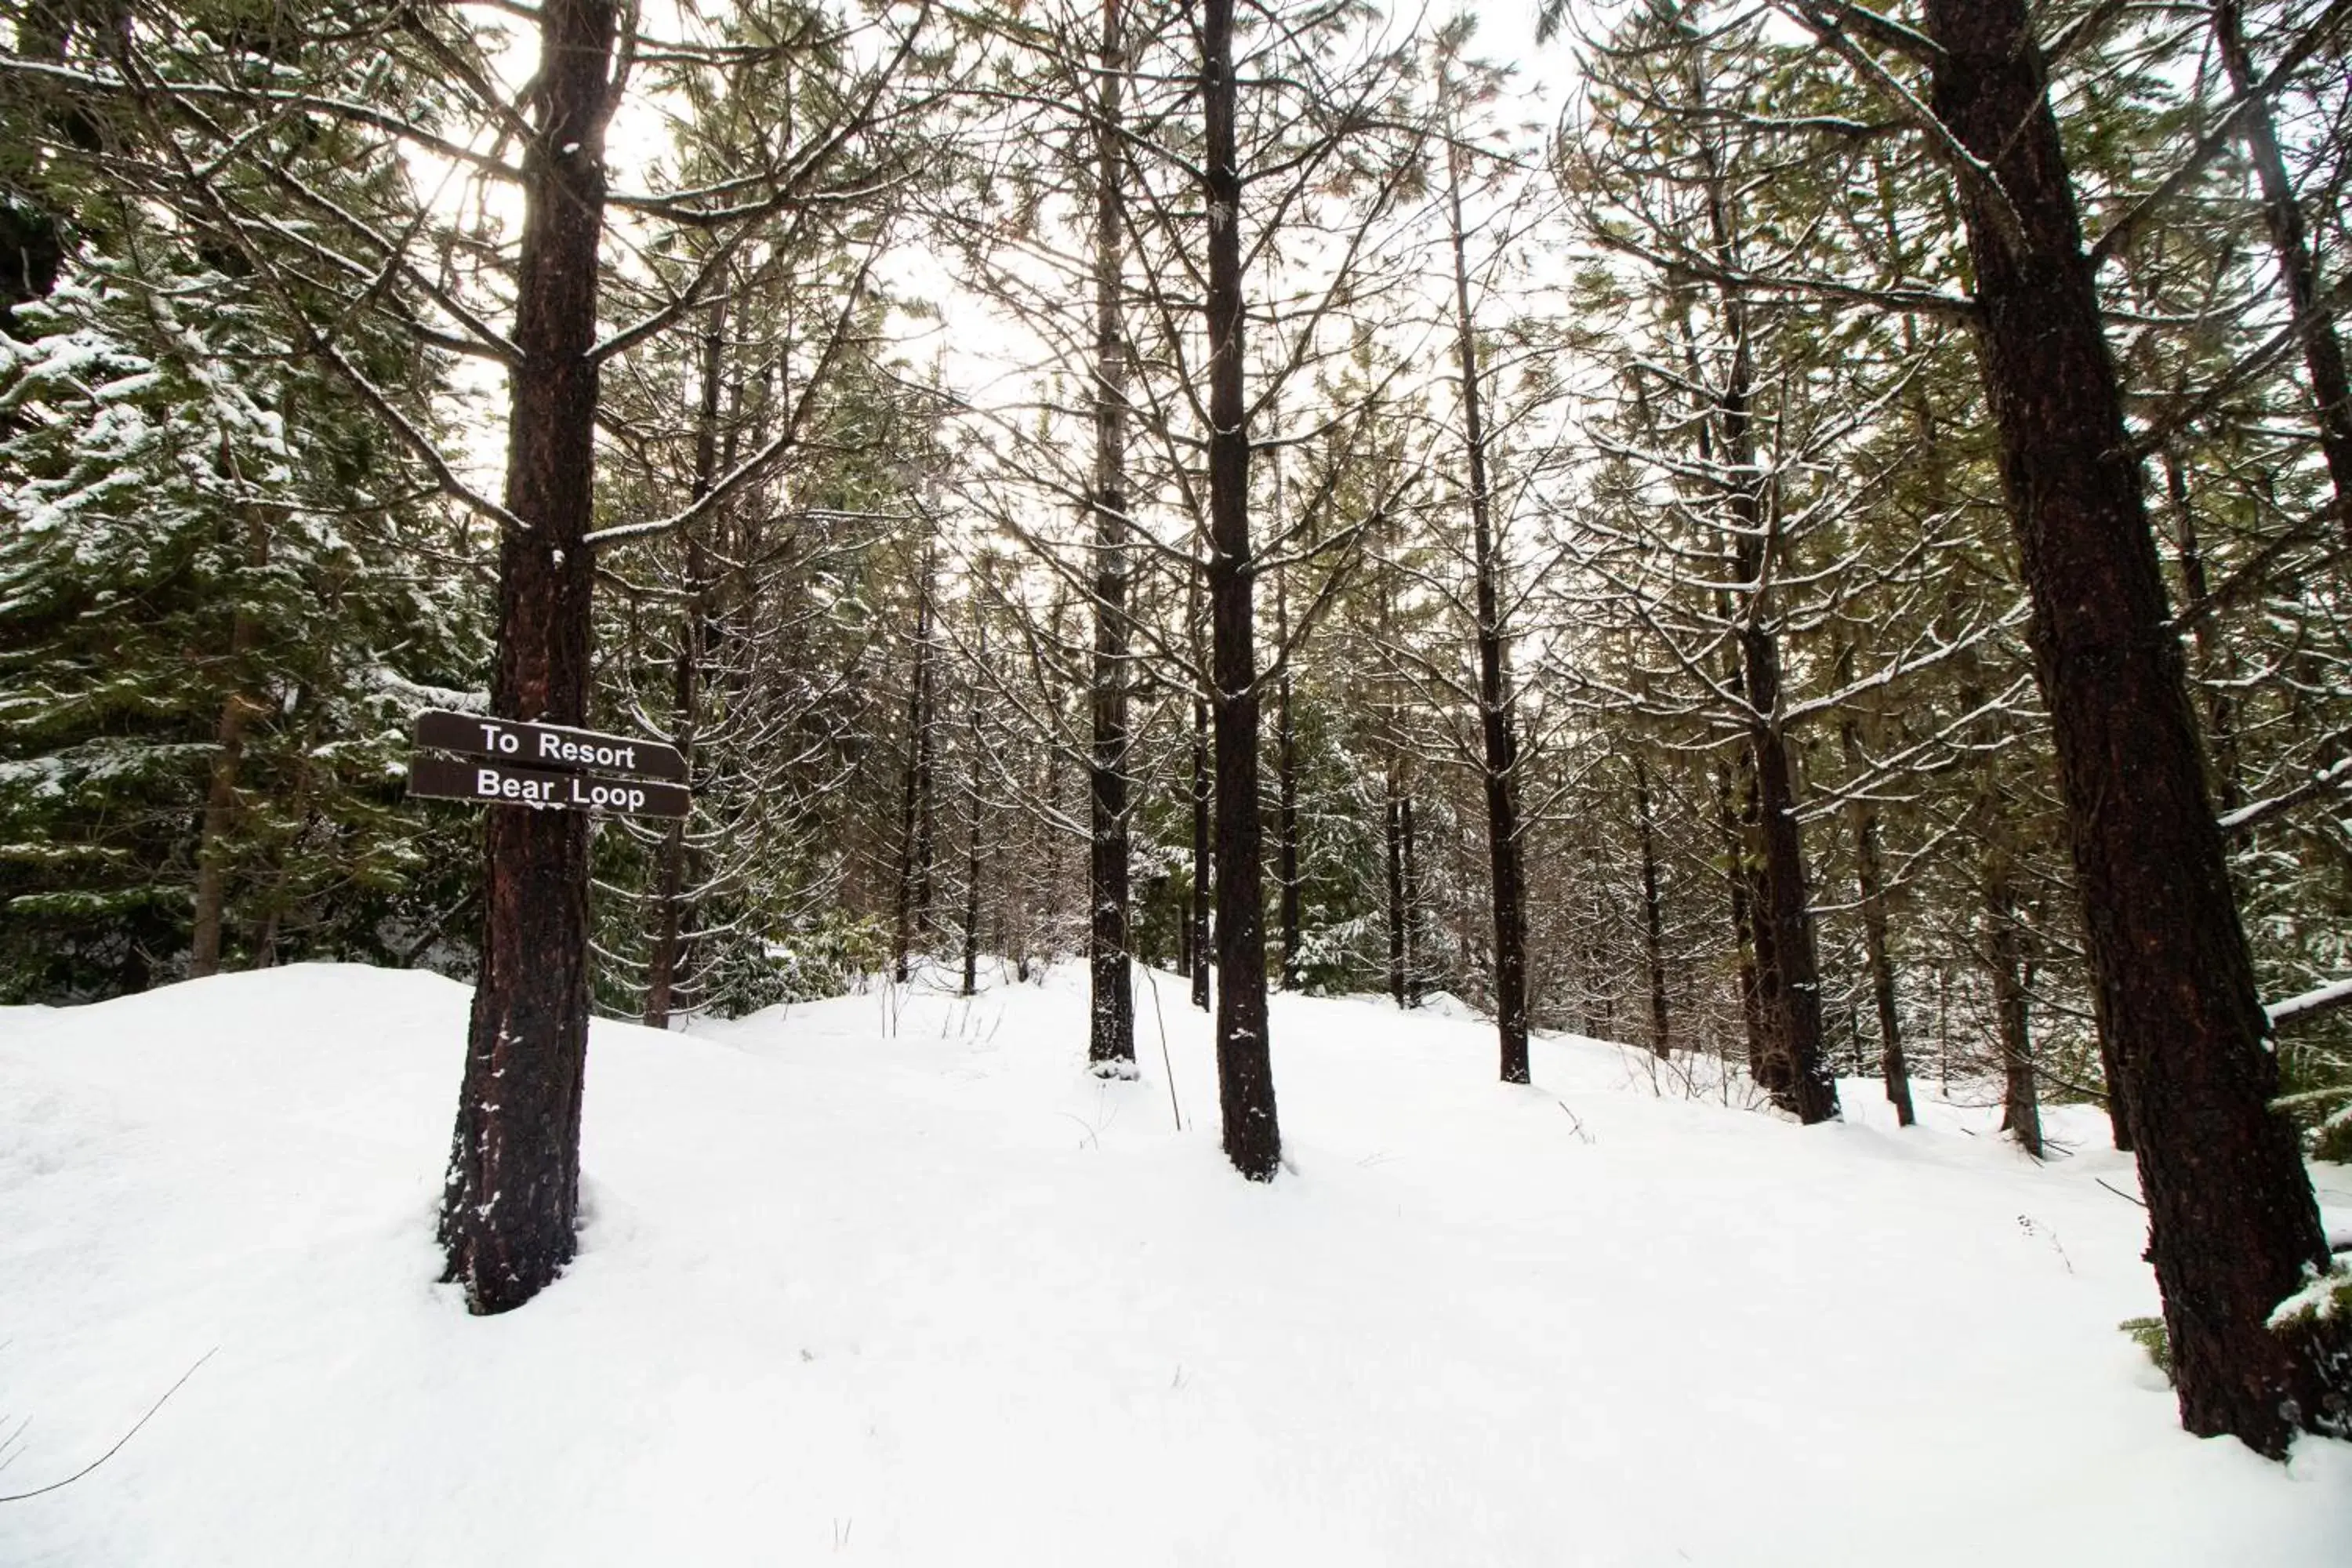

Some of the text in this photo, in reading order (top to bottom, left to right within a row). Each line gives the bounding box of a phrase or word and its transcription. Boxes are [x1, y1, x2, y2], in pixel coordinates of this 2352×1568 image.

[480, 724, 635, 769] To Resort
[477, 769, 644, 812] Bear Loop
